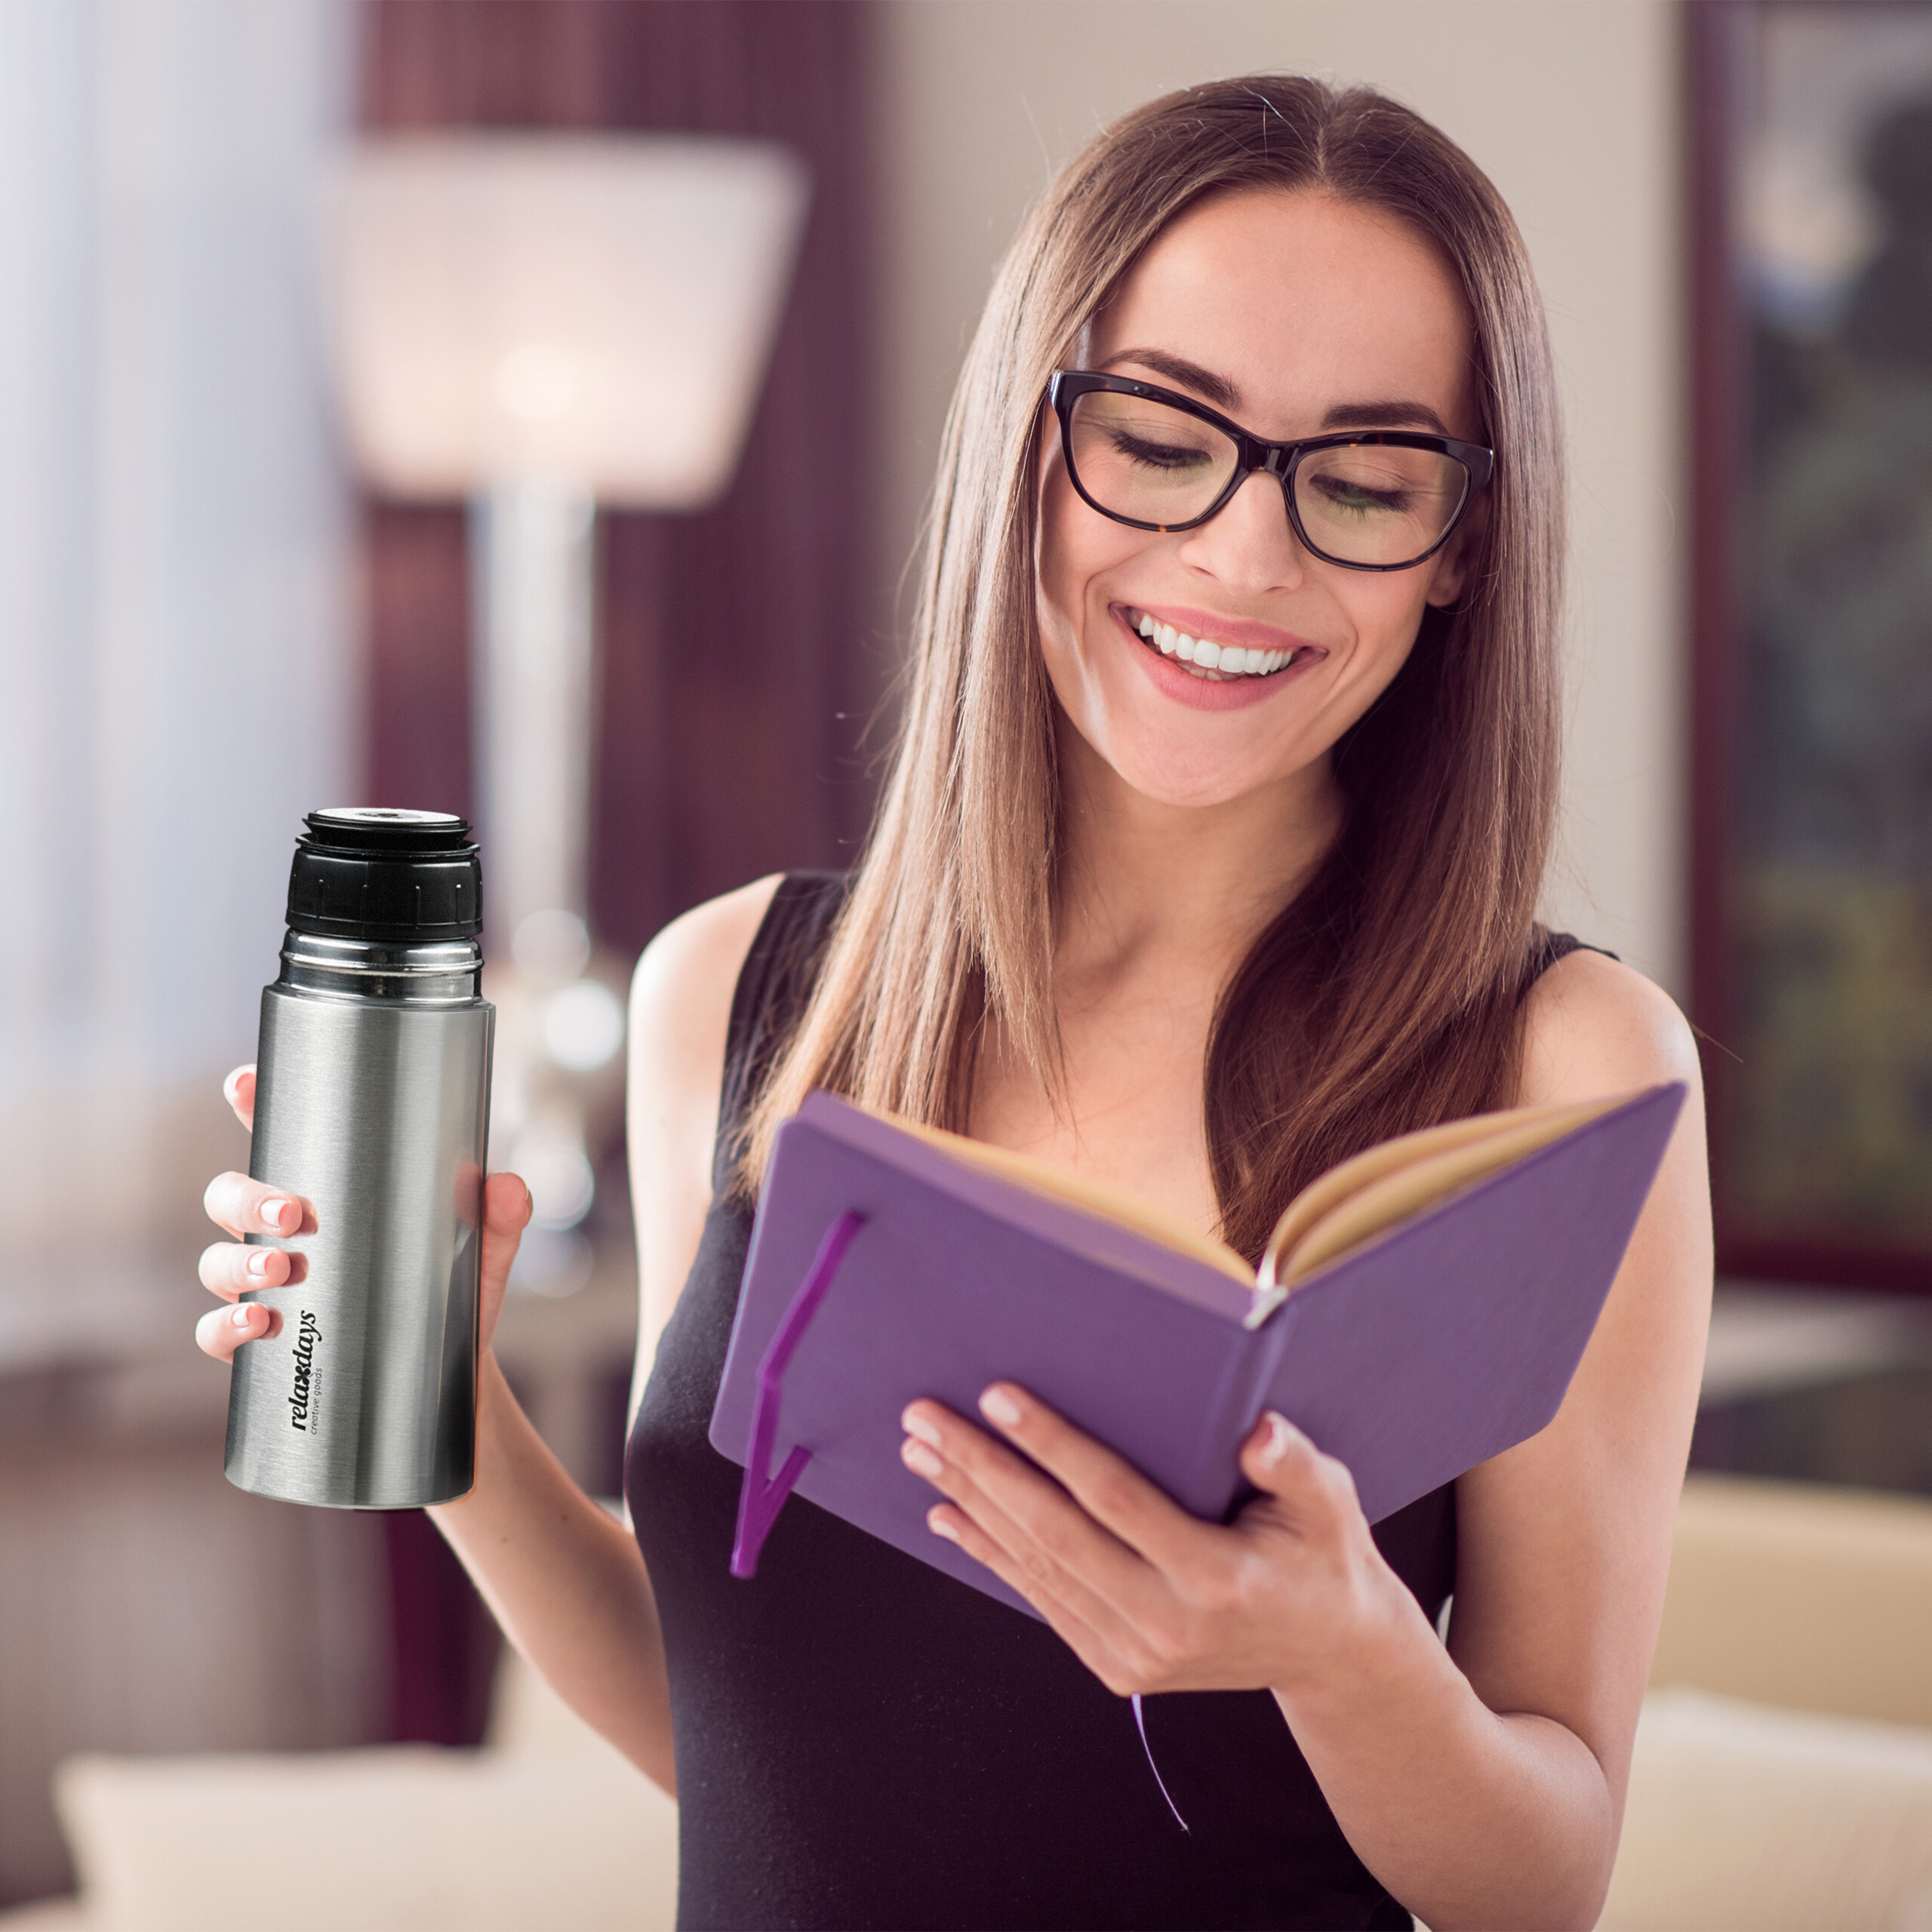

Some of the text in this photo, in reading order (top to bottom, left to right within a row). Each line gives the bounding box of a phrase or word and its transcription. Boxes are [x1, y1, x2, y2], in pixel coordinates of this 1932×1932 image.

[288, 1309, 322, 1432] relaxdays
[310, 1367, 323, 1435] creative goods
